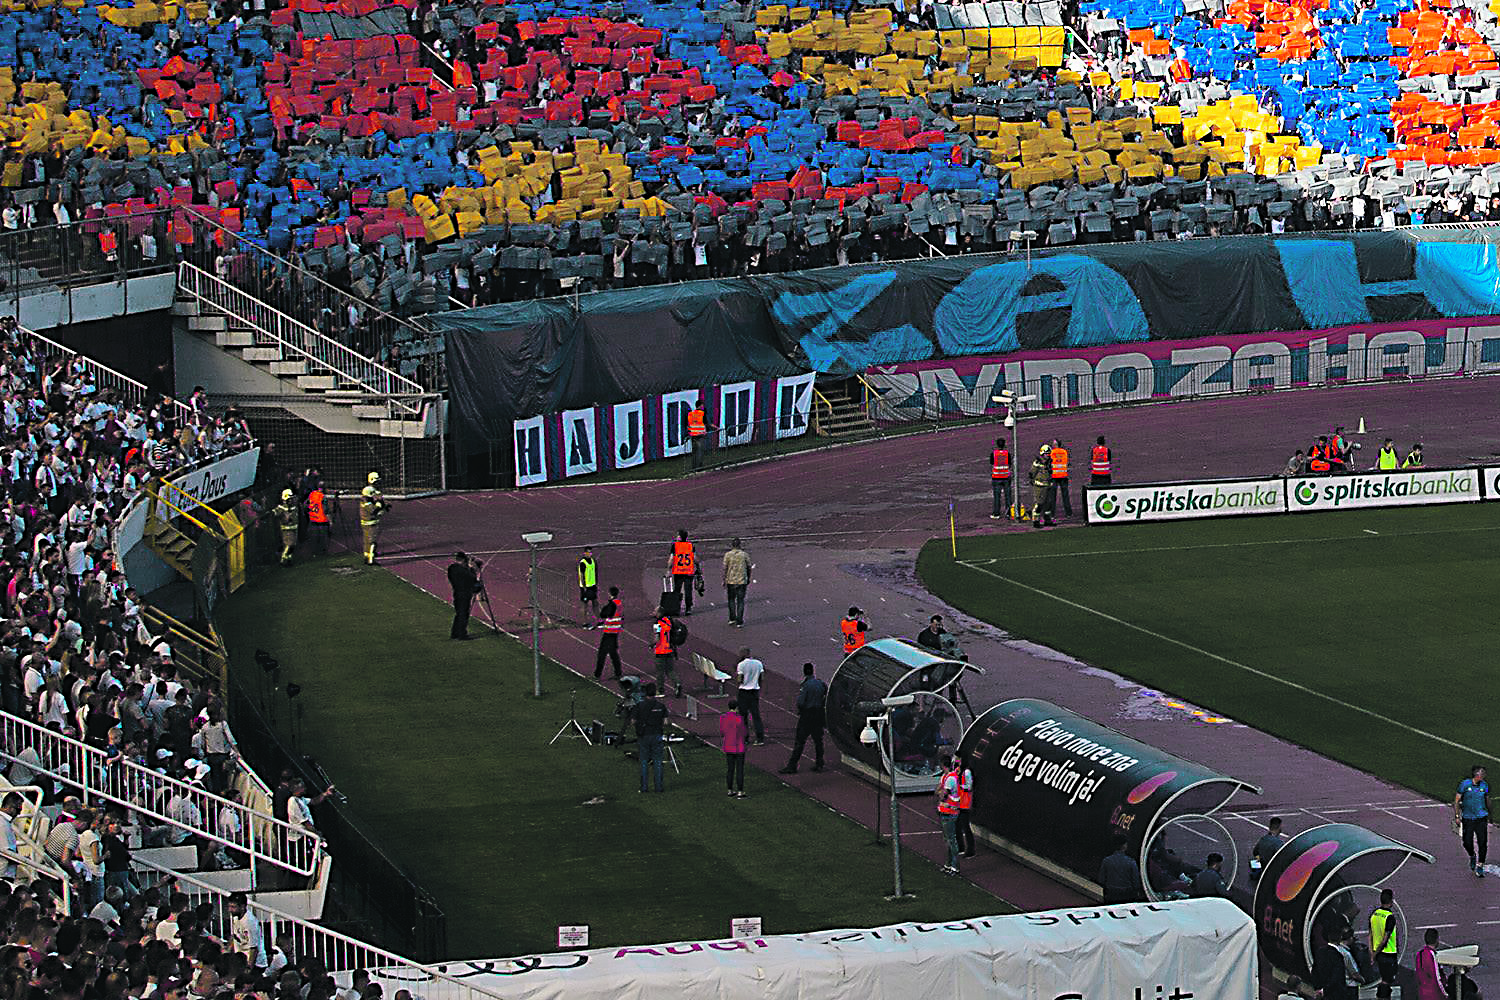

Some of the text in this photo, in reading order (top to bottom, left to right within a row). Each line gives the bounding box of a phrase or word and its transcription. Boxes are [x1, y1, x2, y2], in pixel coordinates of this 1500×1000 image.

[1170, 342, 1292, 396] ZA
[514, 379, 811, 481] HAJDUK
[1124, 487, 1278, 519] splitskabanka
[1323, 471, 1472, 502] splitskabanka
[677, 553, 691, 567] 25
[1000, 739, 1106, 805] da ga volim ja!
[1024, 718, 1075, 747] Plavo
[1062, 734, 1111, 761] more
[1099, 751, 1139, 772] zna
